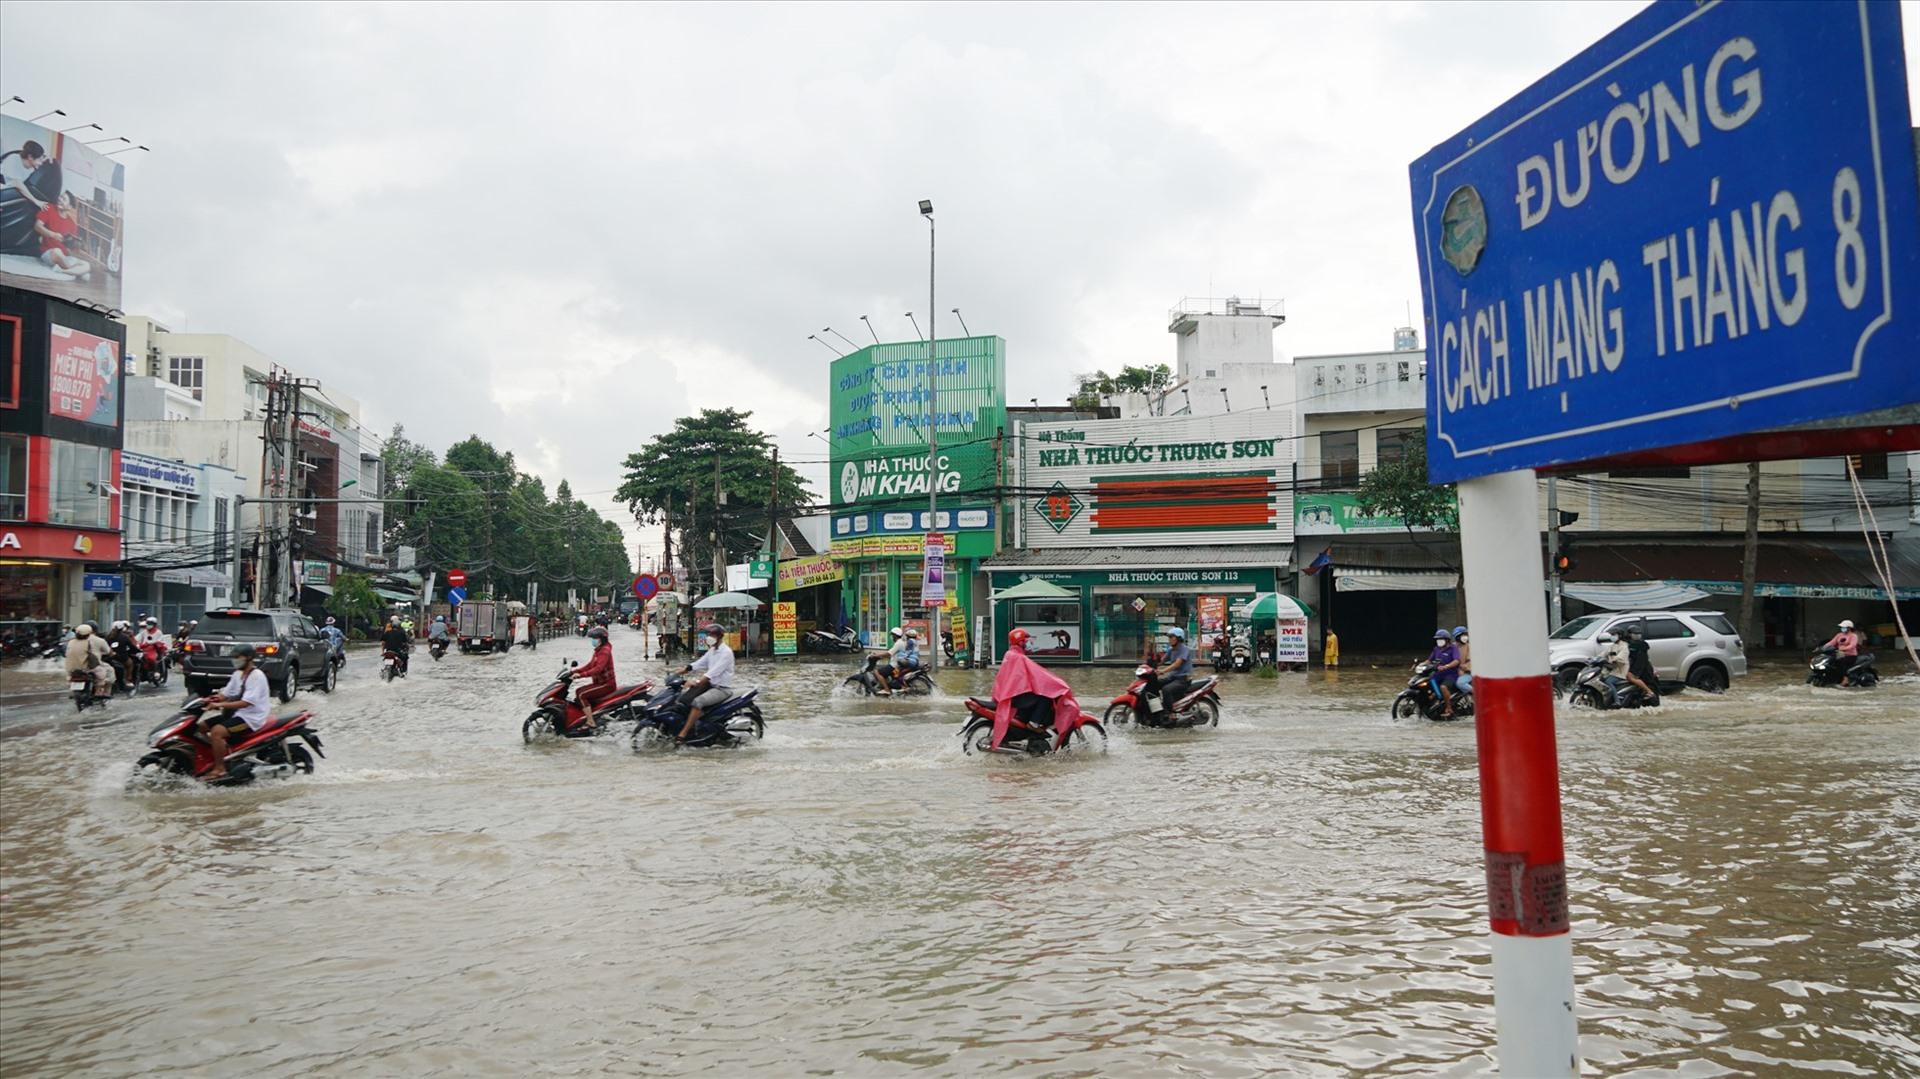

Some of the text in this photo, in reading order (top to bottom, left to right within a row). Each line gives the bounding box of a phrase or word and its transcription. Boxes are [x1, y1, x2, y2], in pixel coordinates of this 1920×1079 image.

[1515, 36, 1762, 231] ĐƯỜNG
[1442, 166, 1866, 413] CÁCH MẠNG THÁNG 8
[1054, 428, 1085, 442] Thống
[864, 454, 949, 474] NHÀ THUỐC
[1039, 438, 1275, 467] NHÀ THUỐC TRUNG SƠN
[859, 471, 961, 497] AN KHANG
[1047, 496, 1071, 519] TS
[780, 565, 790, 580] GÀ
[807, 558, 831, 574] THUỐC
[1108, 570, 1239, 582] NHÀ THUỐC TRUNG SƠN 113
